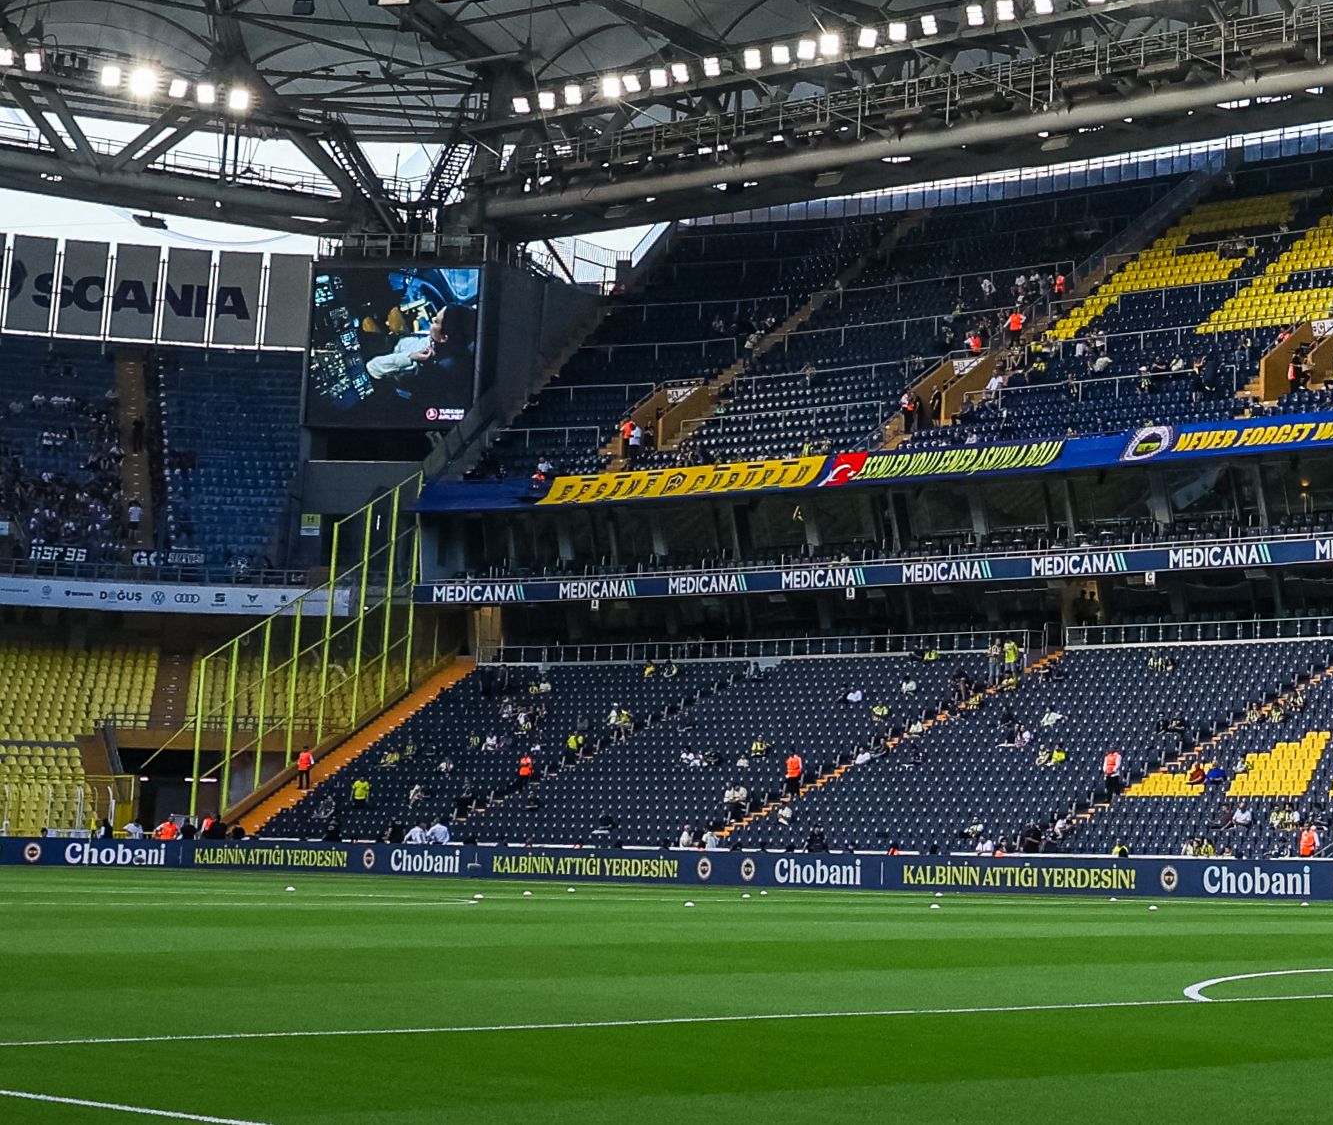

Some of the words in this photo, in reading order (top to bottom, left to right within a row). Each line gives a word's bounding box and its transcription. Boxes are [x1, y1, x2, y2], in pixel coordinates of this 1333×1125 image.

[32, 272, 250, 321] SCANIA
[1171, 431, 1235, 453] NEVER
[1236, 424, 1315, 447] FORGET
[433, 584, 515, 602] MEDICANA
[558, 580, 627, 598] MEDICANA
[668, 575, 738, 594] MEDICANA
[781, 568, 856, 587] MEDICANA
[902, 561, 982, 582] MEDICANA
[1031, 553, 1117, 577] MEDICANA
[1169, 544, 1261, 568] MEDICANA
[65, 842, 165, 865] Chobani
[194, 845, 246, 864] KALBİNİN
[247, 845, 284, 865] ATTIĞI
[285, 847, 347, 867] YERDESİN!
[390, 848, 460, 873] Chobani
[492, 853, 554, 876] KALBİNİN
[556, 853, 601, 876] ATTIĞI
[603, 855, 678, 878] YERDESİN!
[774, 858, 862, 885] Chobani
[902, 861, 982, 885] KALBİNİN
[984, 861, 1039, 887] ATTIĞI
[1041, 863, 1136, 889] YERDESİN!
[1203, 865, 1311, 895] Chobani
